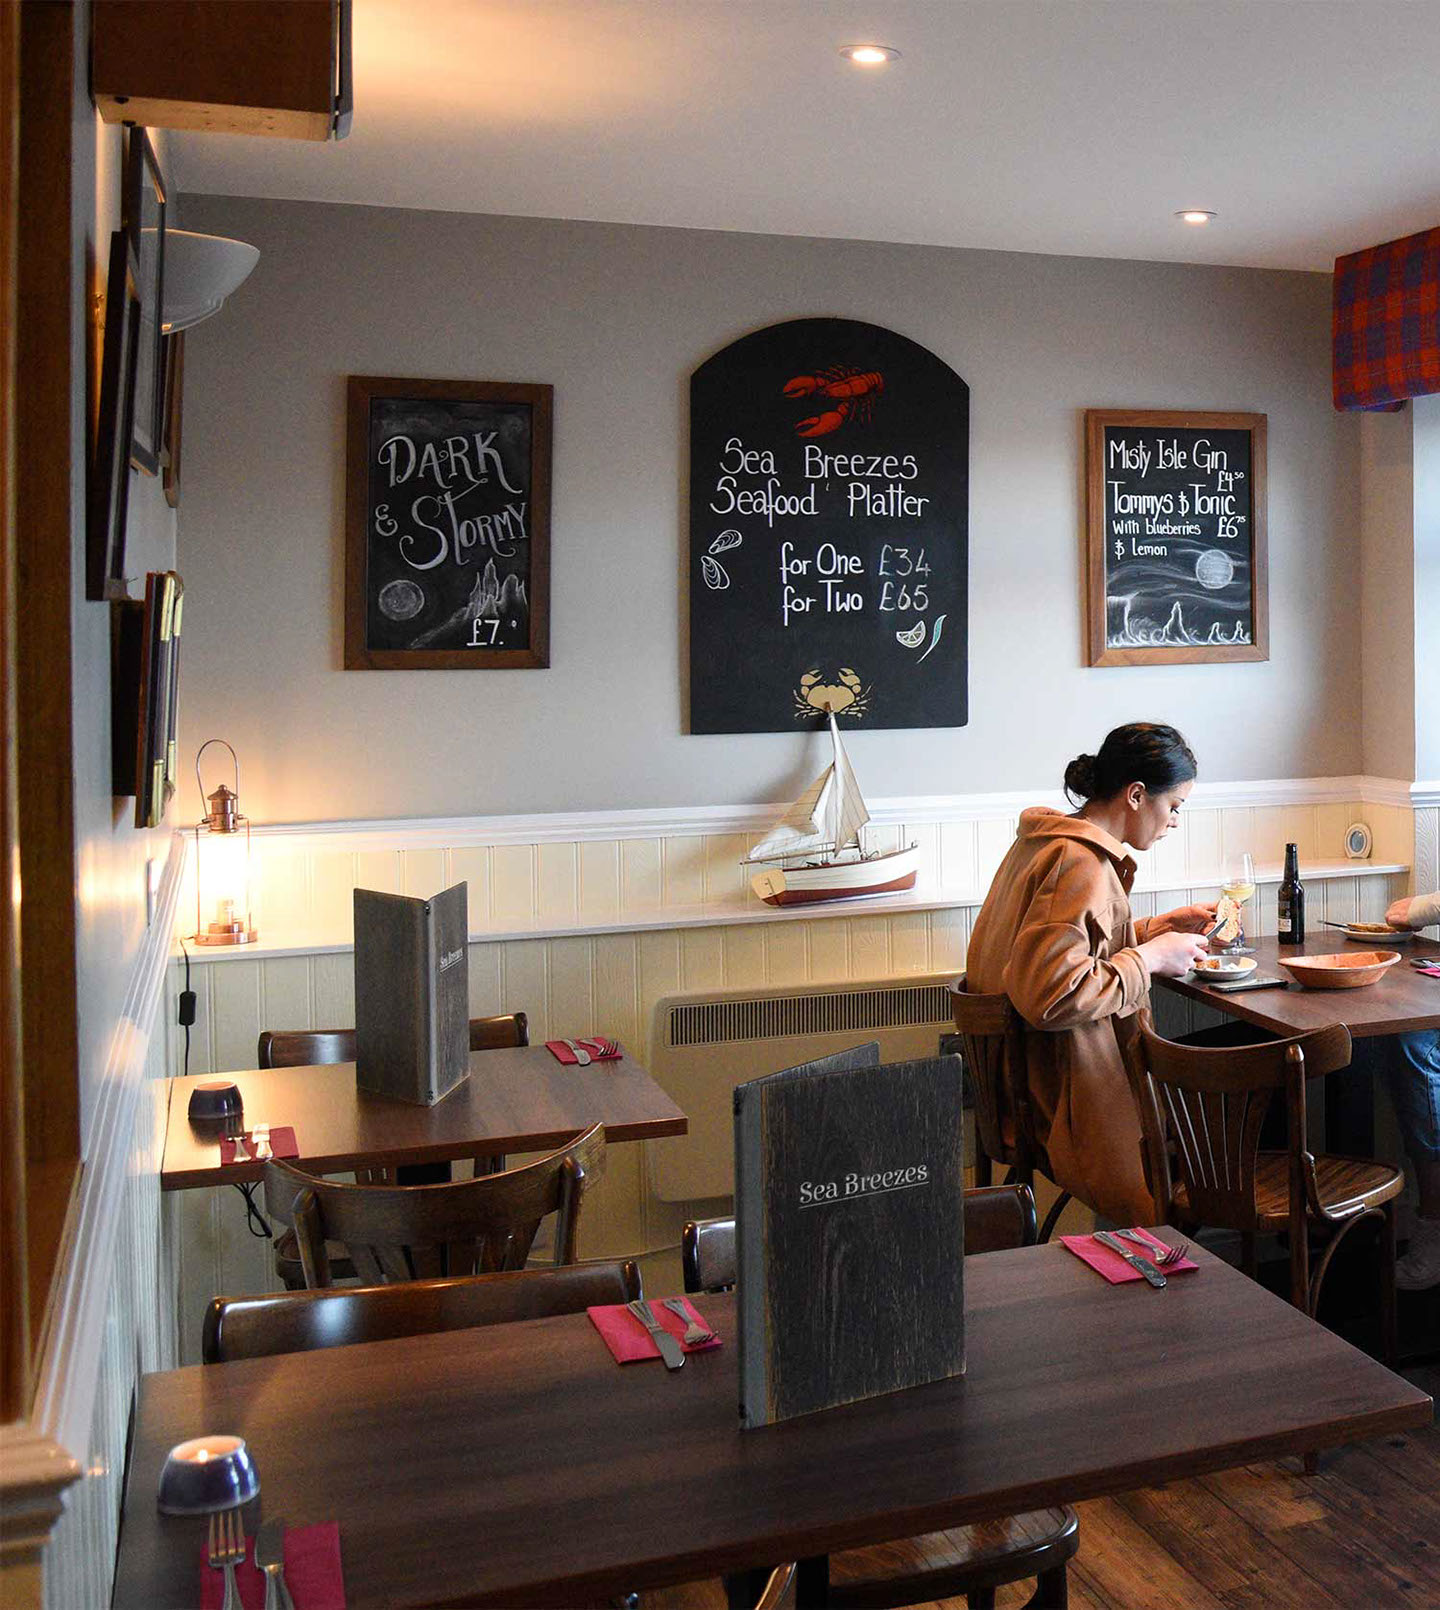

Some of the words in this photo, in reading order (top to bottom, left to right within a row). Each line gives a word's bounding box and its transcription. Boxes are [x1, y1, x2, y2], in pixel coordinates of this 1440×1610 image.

[378, 432, 523, 494] DARK
[720, 437, 778, 475] Sea
[804, 445, 918, 479] Breezes
[1110, 439, 1152, 478] Misty
[1156, 439, 1187, 469] Isle
[1192, 439, 1228, 474] Gin
[375, 503, 398, 536] &
[710, 476, 819, 528] Seafood
[847, 482, 929, 517] Platter
[1107, 481, 1174, 522] Tommys
[1188, 484, 1236, 515] Tonic
[1145, 518, 1201, 536] blueberries
[779, 541, 812, 584] for
[816, 542, 864, 576] One
[878, 543, 932, 578] £34
[782, 585, 816, 627] for
[818, 579, 863, 613] Two
[878, 581, 929, 612] £65
[800, 1181, 838, 1203] Sea
[844, 1164, 928, 1196] Breezes
